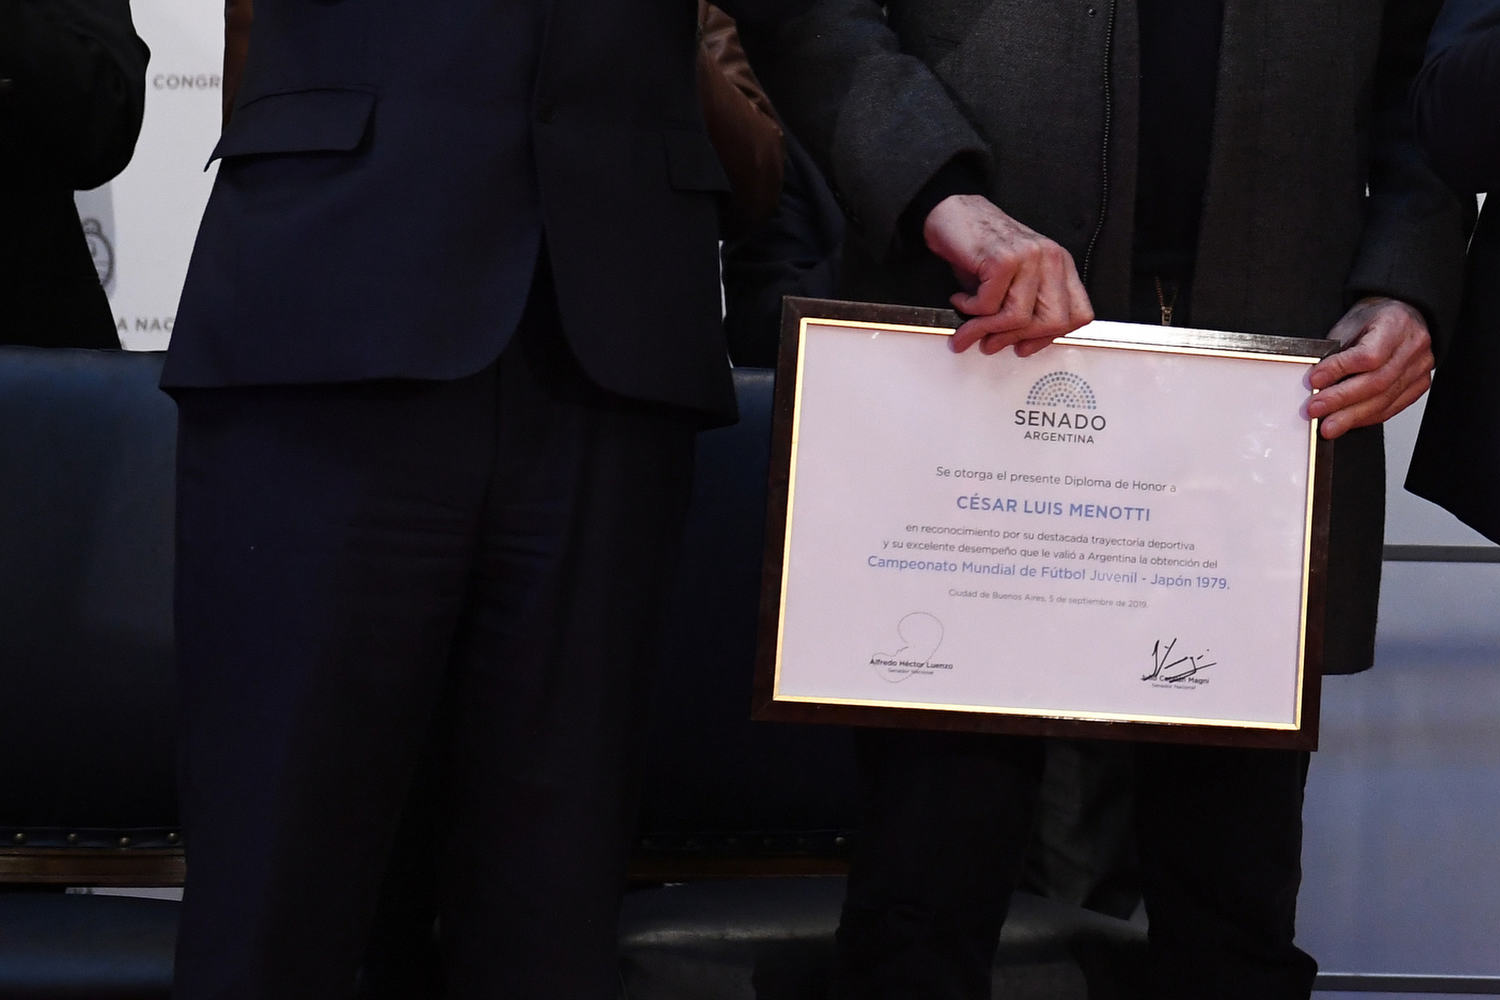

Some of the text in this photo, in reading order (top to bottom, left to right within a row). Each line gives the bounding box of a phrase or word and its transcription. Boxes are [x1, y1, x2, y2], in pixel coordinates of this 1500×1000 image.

[153, 74, 221, 89] CONGR
[136, 316, 174, 332] NAC
[1014, 409, 1107, 432] SENADO
[1023, 431, 1095, 444] ARGENTINA
[936, 466, 1177, 493] Se otorga el presente Diploma de Honor a
[956, 493, 1150, 521] CÉSAR LUIS MENOTTI
[905, 524, 918, 532] en
[921, 525, 1000, 538] reconocimiento
[1003, 530, 1020, 540] por
[1037, 532, 1088, 544] destacada
[1092, 535, 1145, 548] trayectoria
[1148, 539, 1195, 551] deportiva
[883, 541, 888, 549] y
[892, 541, 903, 549] su
[906, 541, 955, 552] excelente
[958, 543, 1017, 556] desempeño
[1020, 549, 1039, 559] que
[1042, 548, 1050, 557] le
[1053, 550, 1076, 560] valió
[1088, 552, 1136, 564] Argentina
[1139, 555, 1148, 564] la
[1150, 555, 1200, 568] obtención
[1203, 560, 1218, 569] del
[868, 556, 957, 572] Campeonato
[962, 561, 1015, 576] Mundial
[1020, 564, 1036, 577] de
[1041, 566, 1086, 580] Fútbol
[1090, 570, 1137, 583] Juvenil
[1150, 574, 1192, 588] Japón
[1197, 576, 1231, 590] 1979.
[949, 588, 977, 598] Ciudad
[992, 592, 1022, 601] Buenos
[1056, 596, 1066, 604] de
[1069, 597, 1114, 607] septiembre
